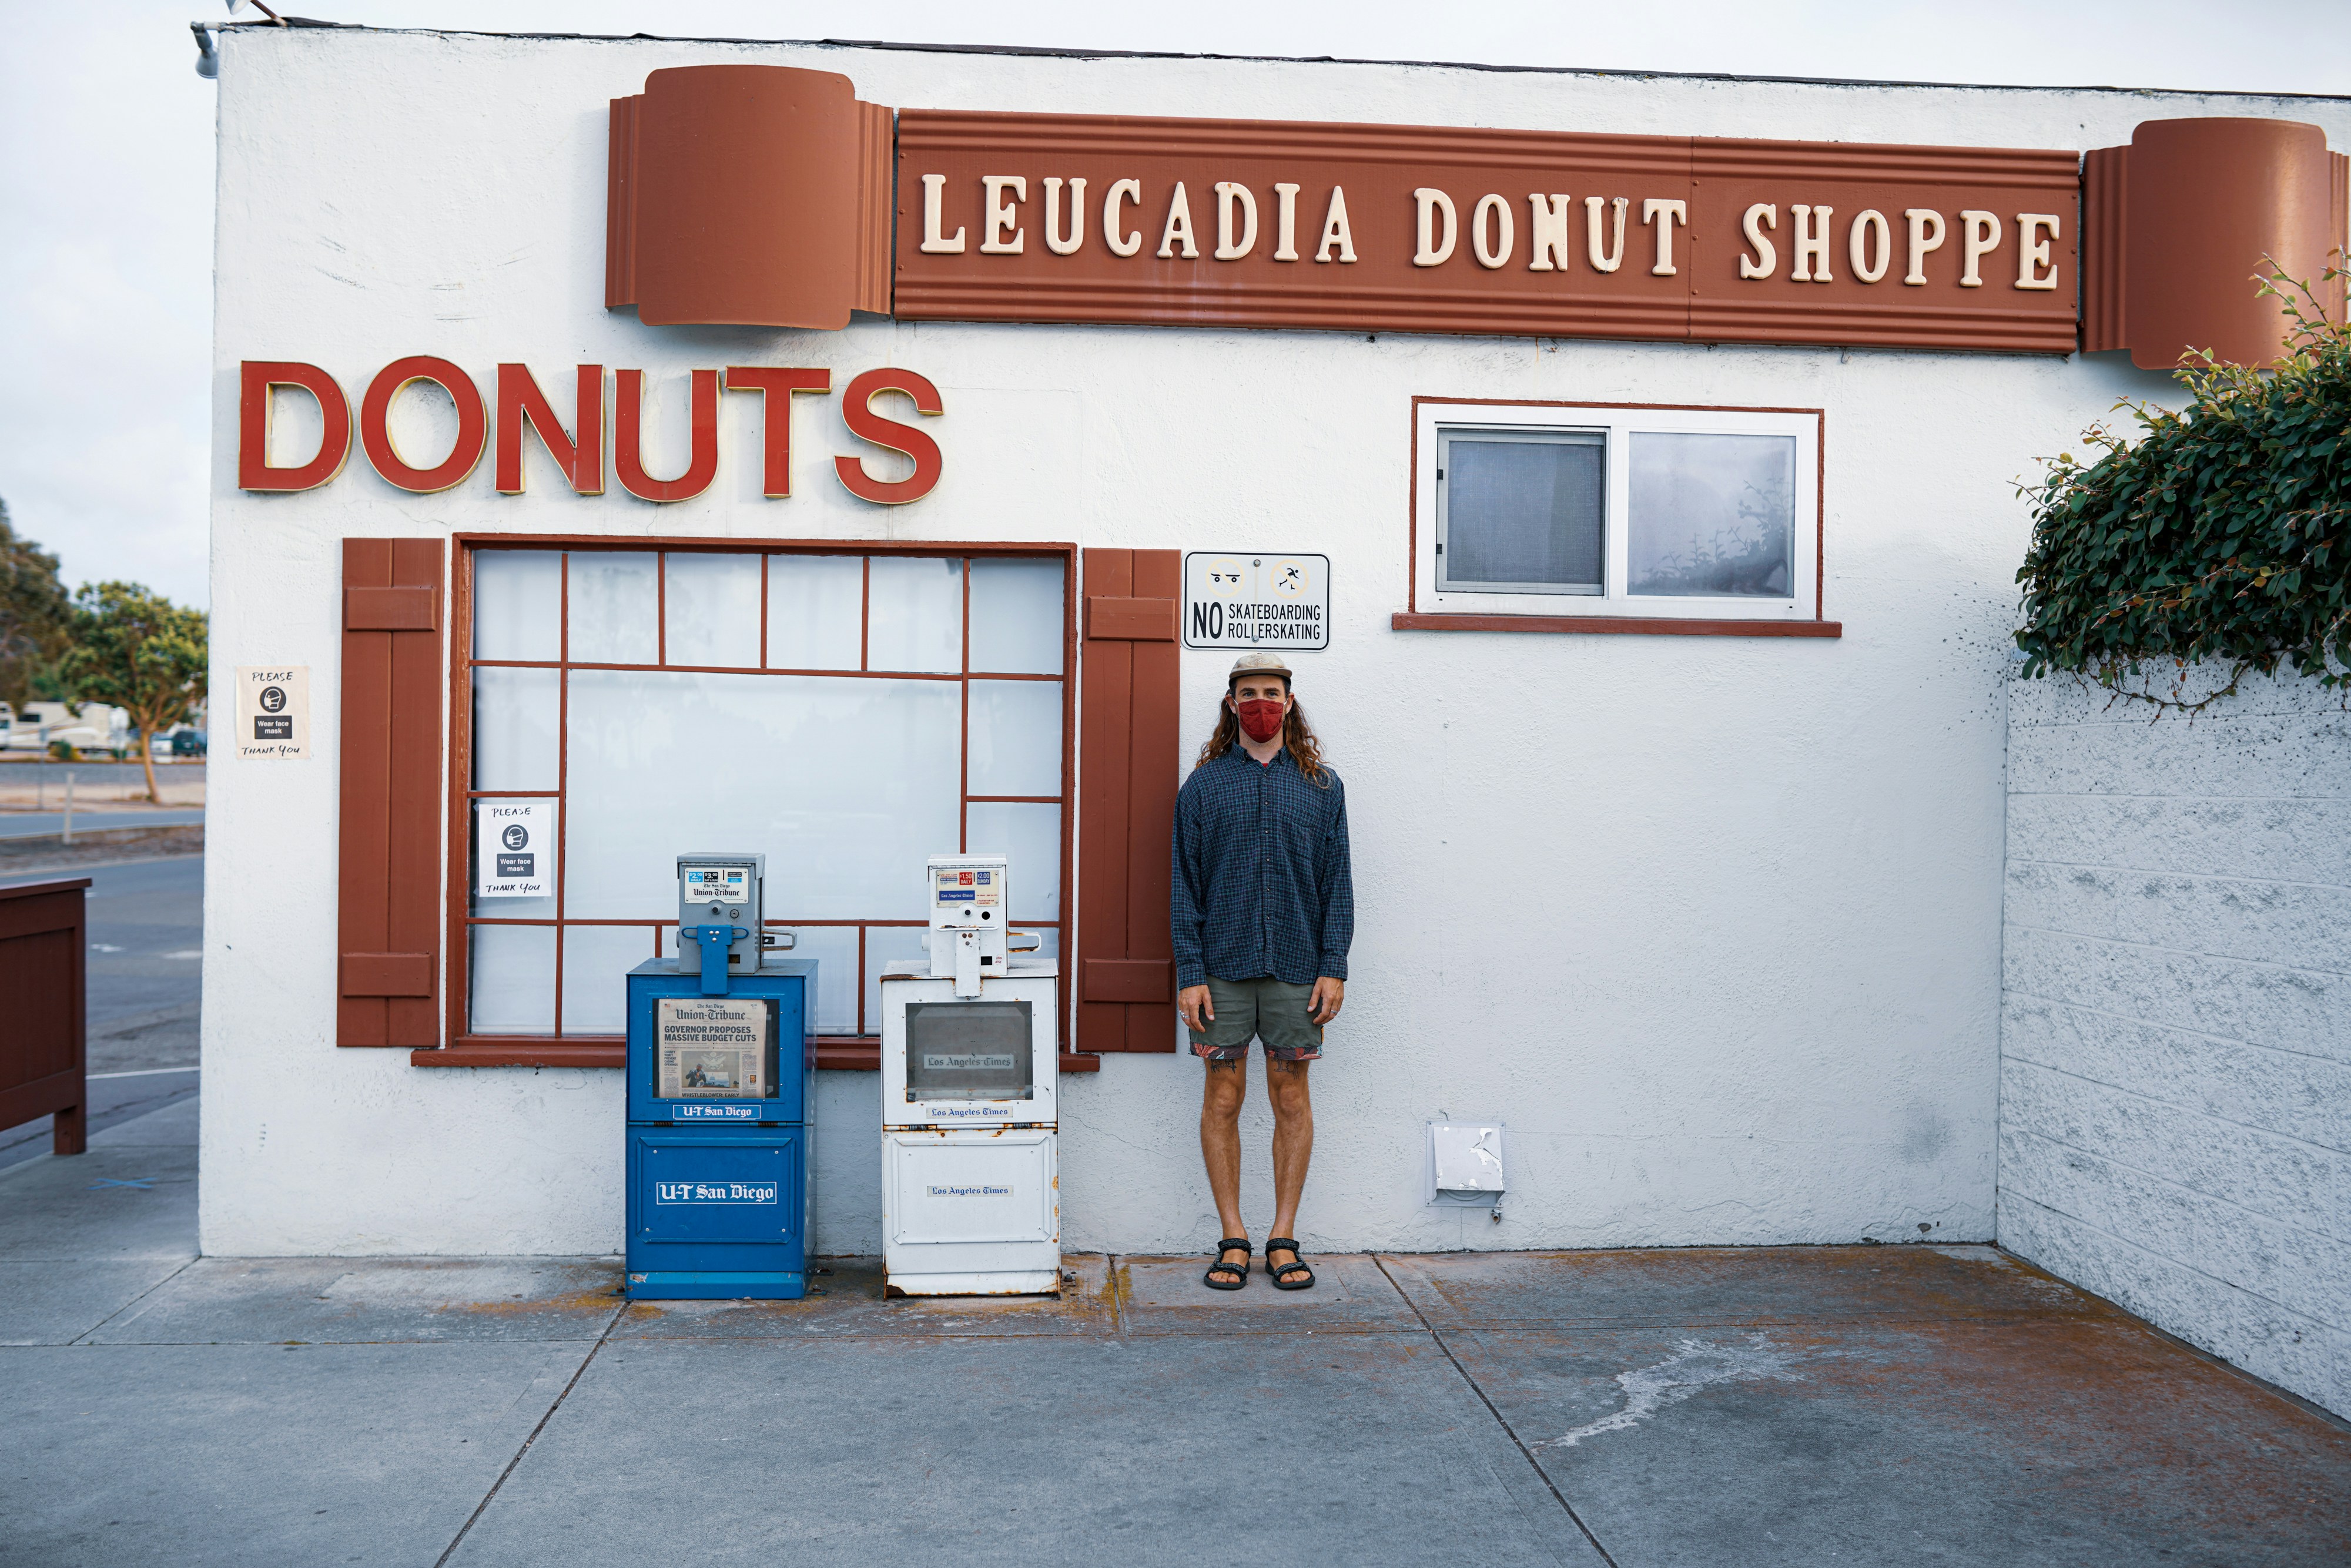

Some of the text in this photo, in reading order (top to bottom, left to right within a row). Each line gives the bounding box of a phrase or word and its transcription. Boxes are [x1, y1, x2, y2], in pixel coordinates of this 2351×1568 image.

[920, 174, 2059, 290] LEUCADIA DONUT SHOPPE
[238, 356, 945, 504] DONUTS
[1193, 602, 1320, 639] NO SKATEBOARDING
[1228, 623, 1320, 639] ROLLERSKATING
[252, 672, 293, 682] PLEASE
[242, 745, 300, 756] THANK YOU
[491, 807, 531, 817] PLEASE
[485, 883, 541, 893] THANK YOU
[676, 1009, 745, 1020] Union-Tribune
[928, 1057, 1010, 1067] Los Angeles Times
[683, 1106, 752, 1117] U-T San Diego
[947, 1108, 980, 1117] Angeles
[660, 1184, 773, 1202] U-T San Diego
[948, 1187, 980, 1195] Angeles
